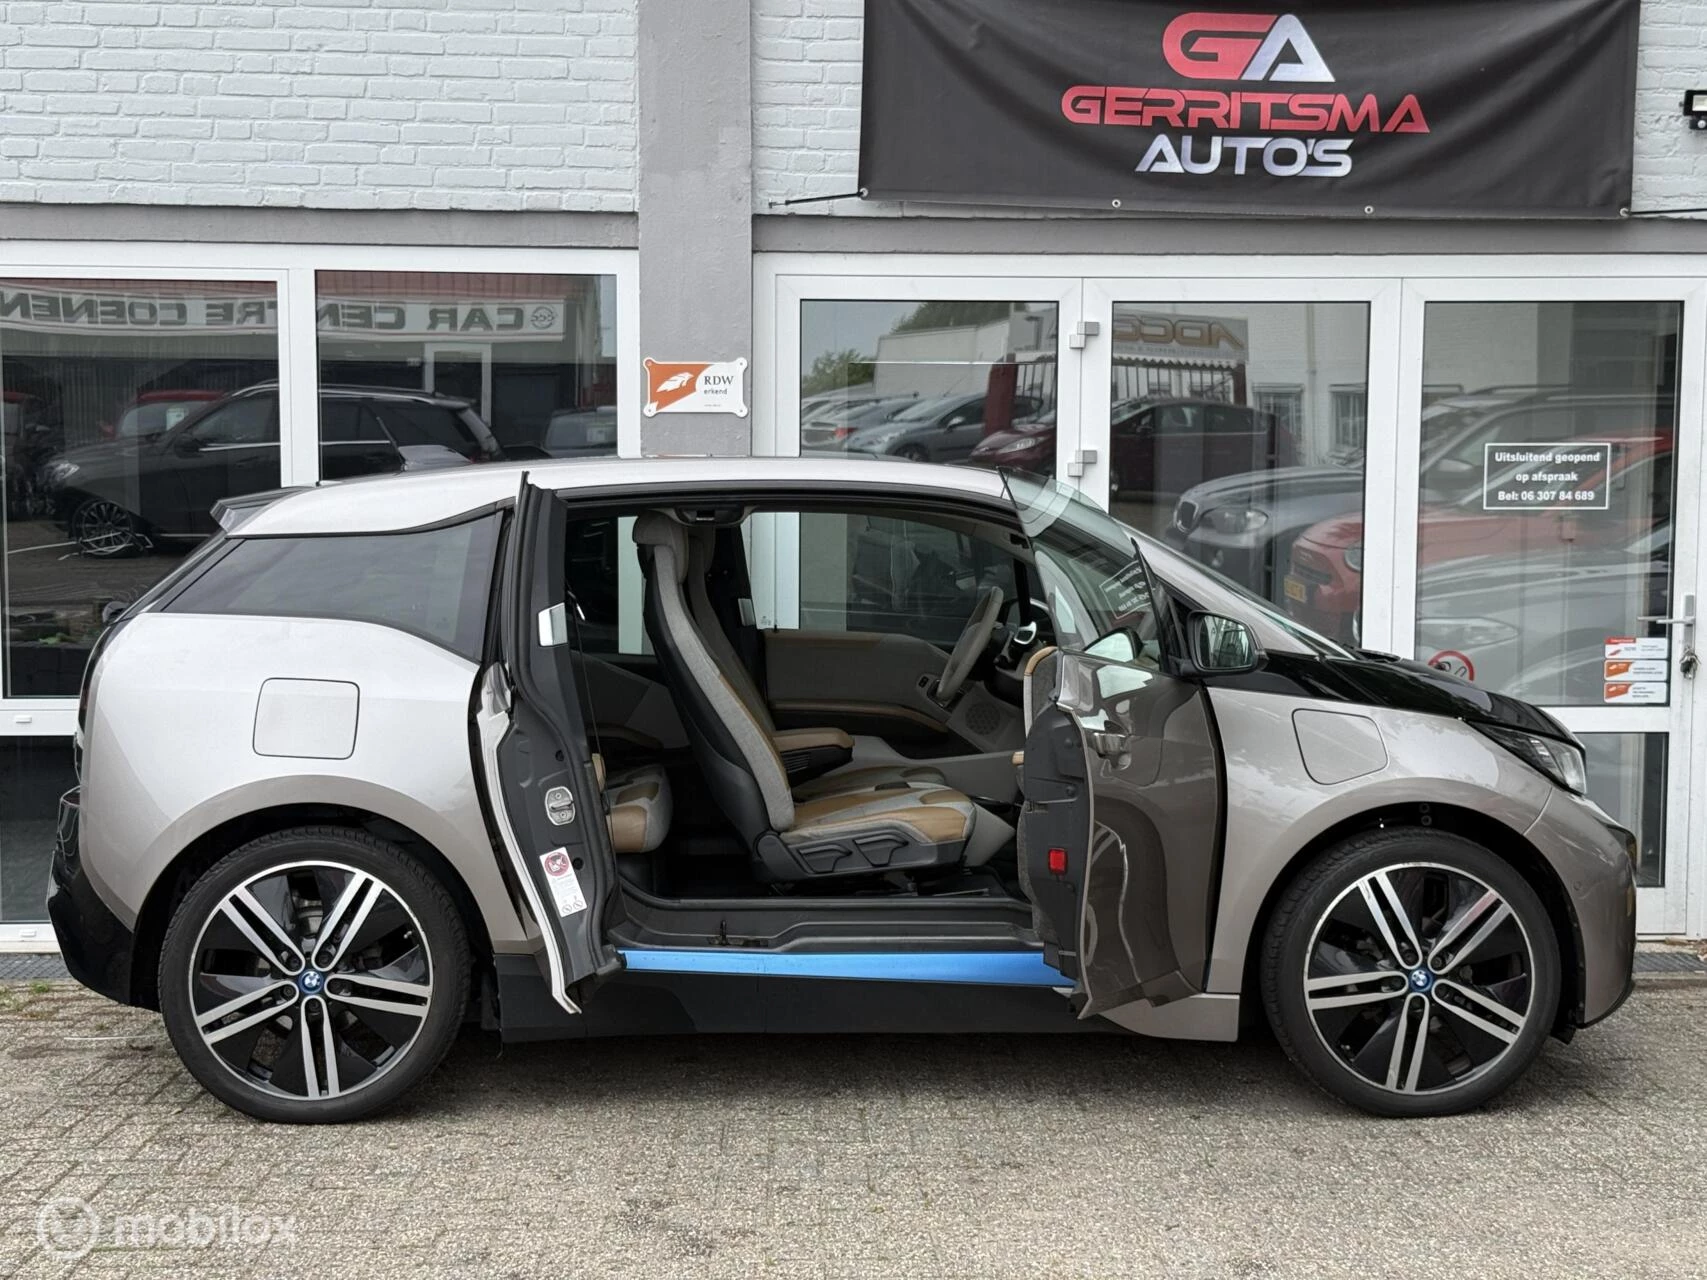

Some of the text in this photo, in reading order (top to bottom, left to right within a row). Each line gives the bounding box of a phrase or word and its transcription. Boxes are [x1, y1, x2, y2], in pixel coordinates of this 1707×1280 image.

[1162, 12, 1336, 82] GA
[1061, 85, 1431, 133] GERRITSMA
[1135, 134, 1354, 177] AUTO'S
[704, 375, 734, 386] RDW
[1494, 452, 1601, 464] Uitsluitend geopend
[1515, 472, 1578, 483] op afspraak
[1498, 491, 1595, 501] Bel: 06 307 84 689
